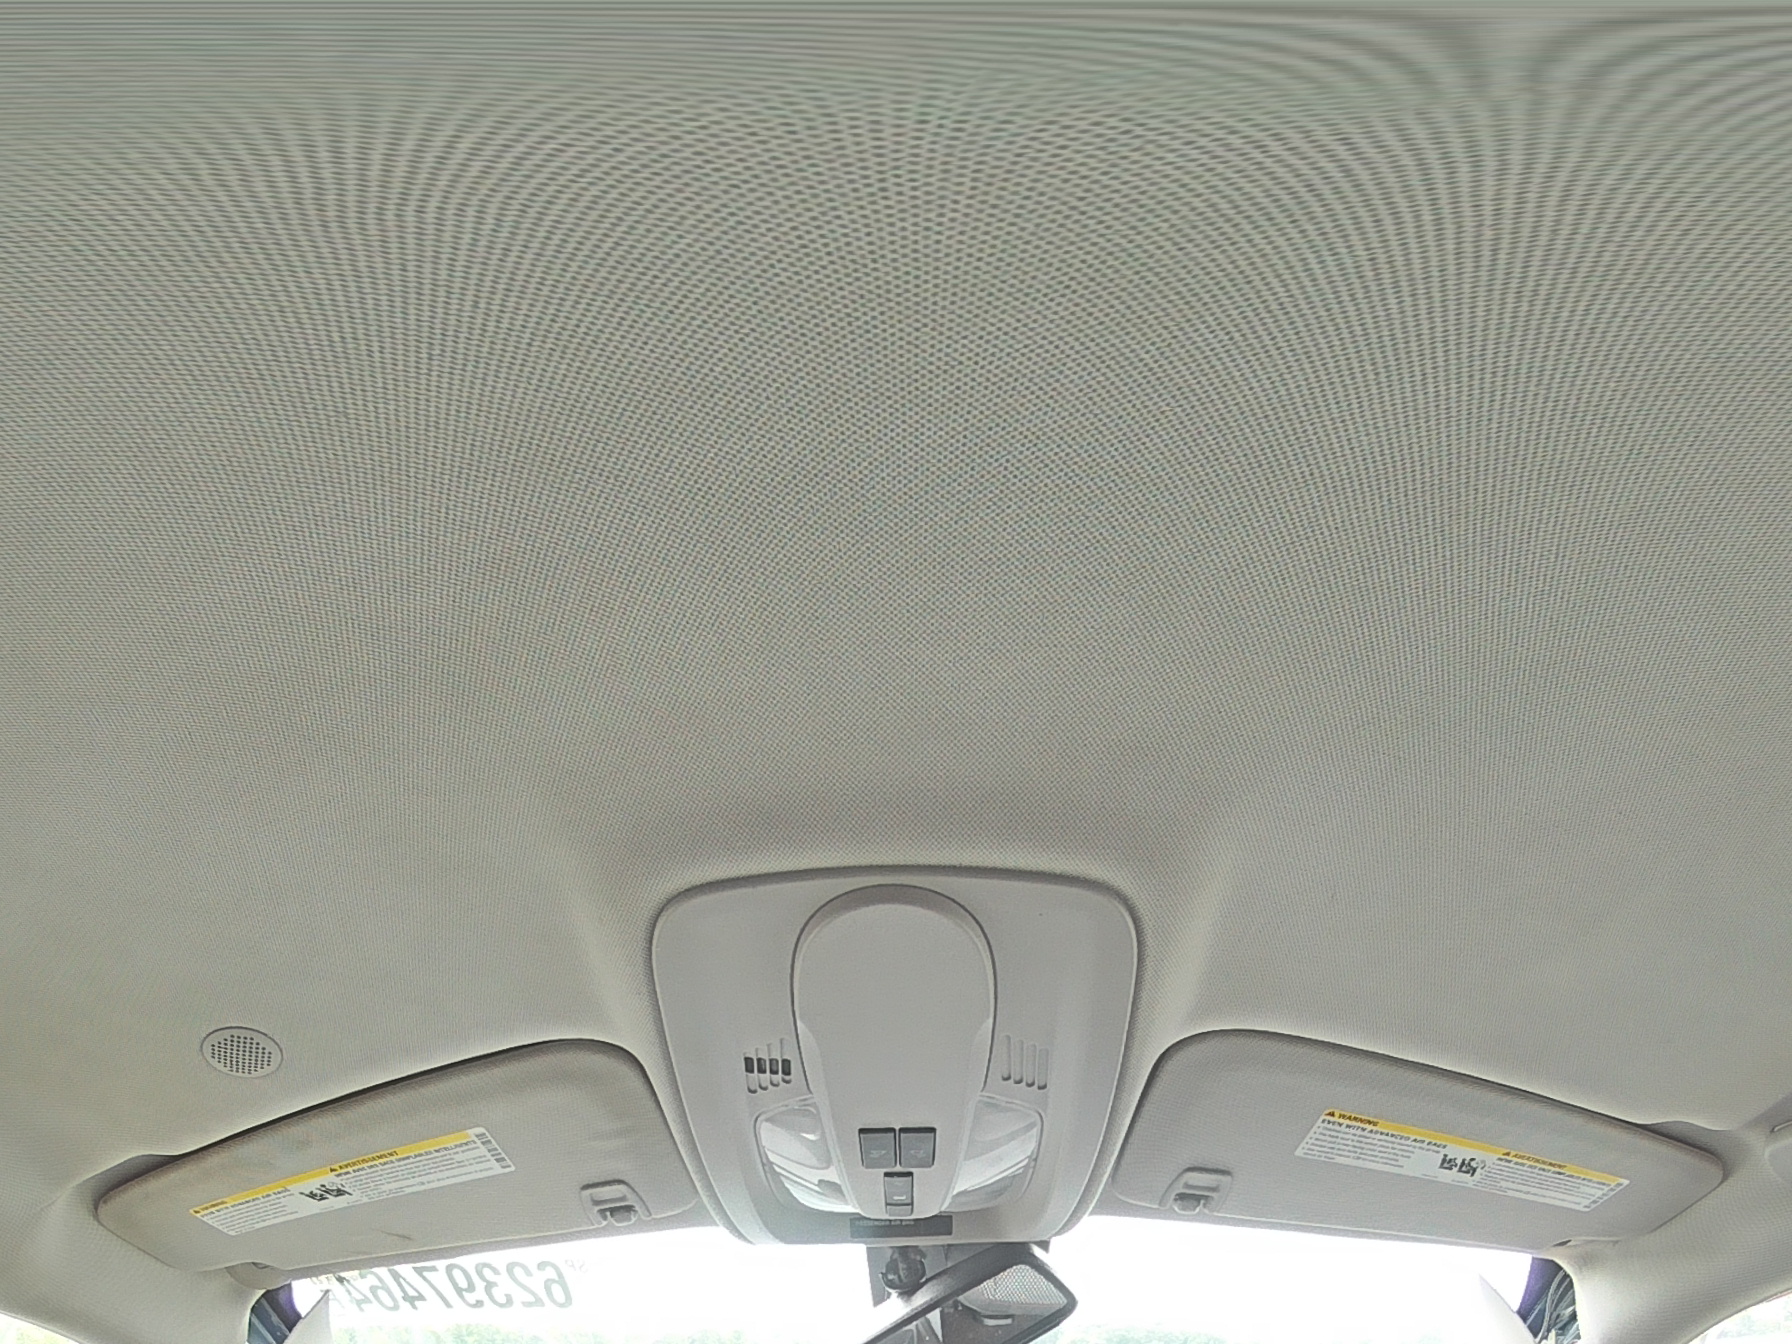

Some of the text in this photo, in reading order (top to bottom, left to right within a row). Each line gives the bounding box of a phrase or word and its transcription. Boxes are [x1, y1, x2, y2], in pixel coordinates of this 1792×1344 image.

[1338, 1112, 1380, 1127] WARNING
[1345, 1123, 1368, 1133] WITH
[337, 1149, 399, 1171] AVERTISSEMENT
